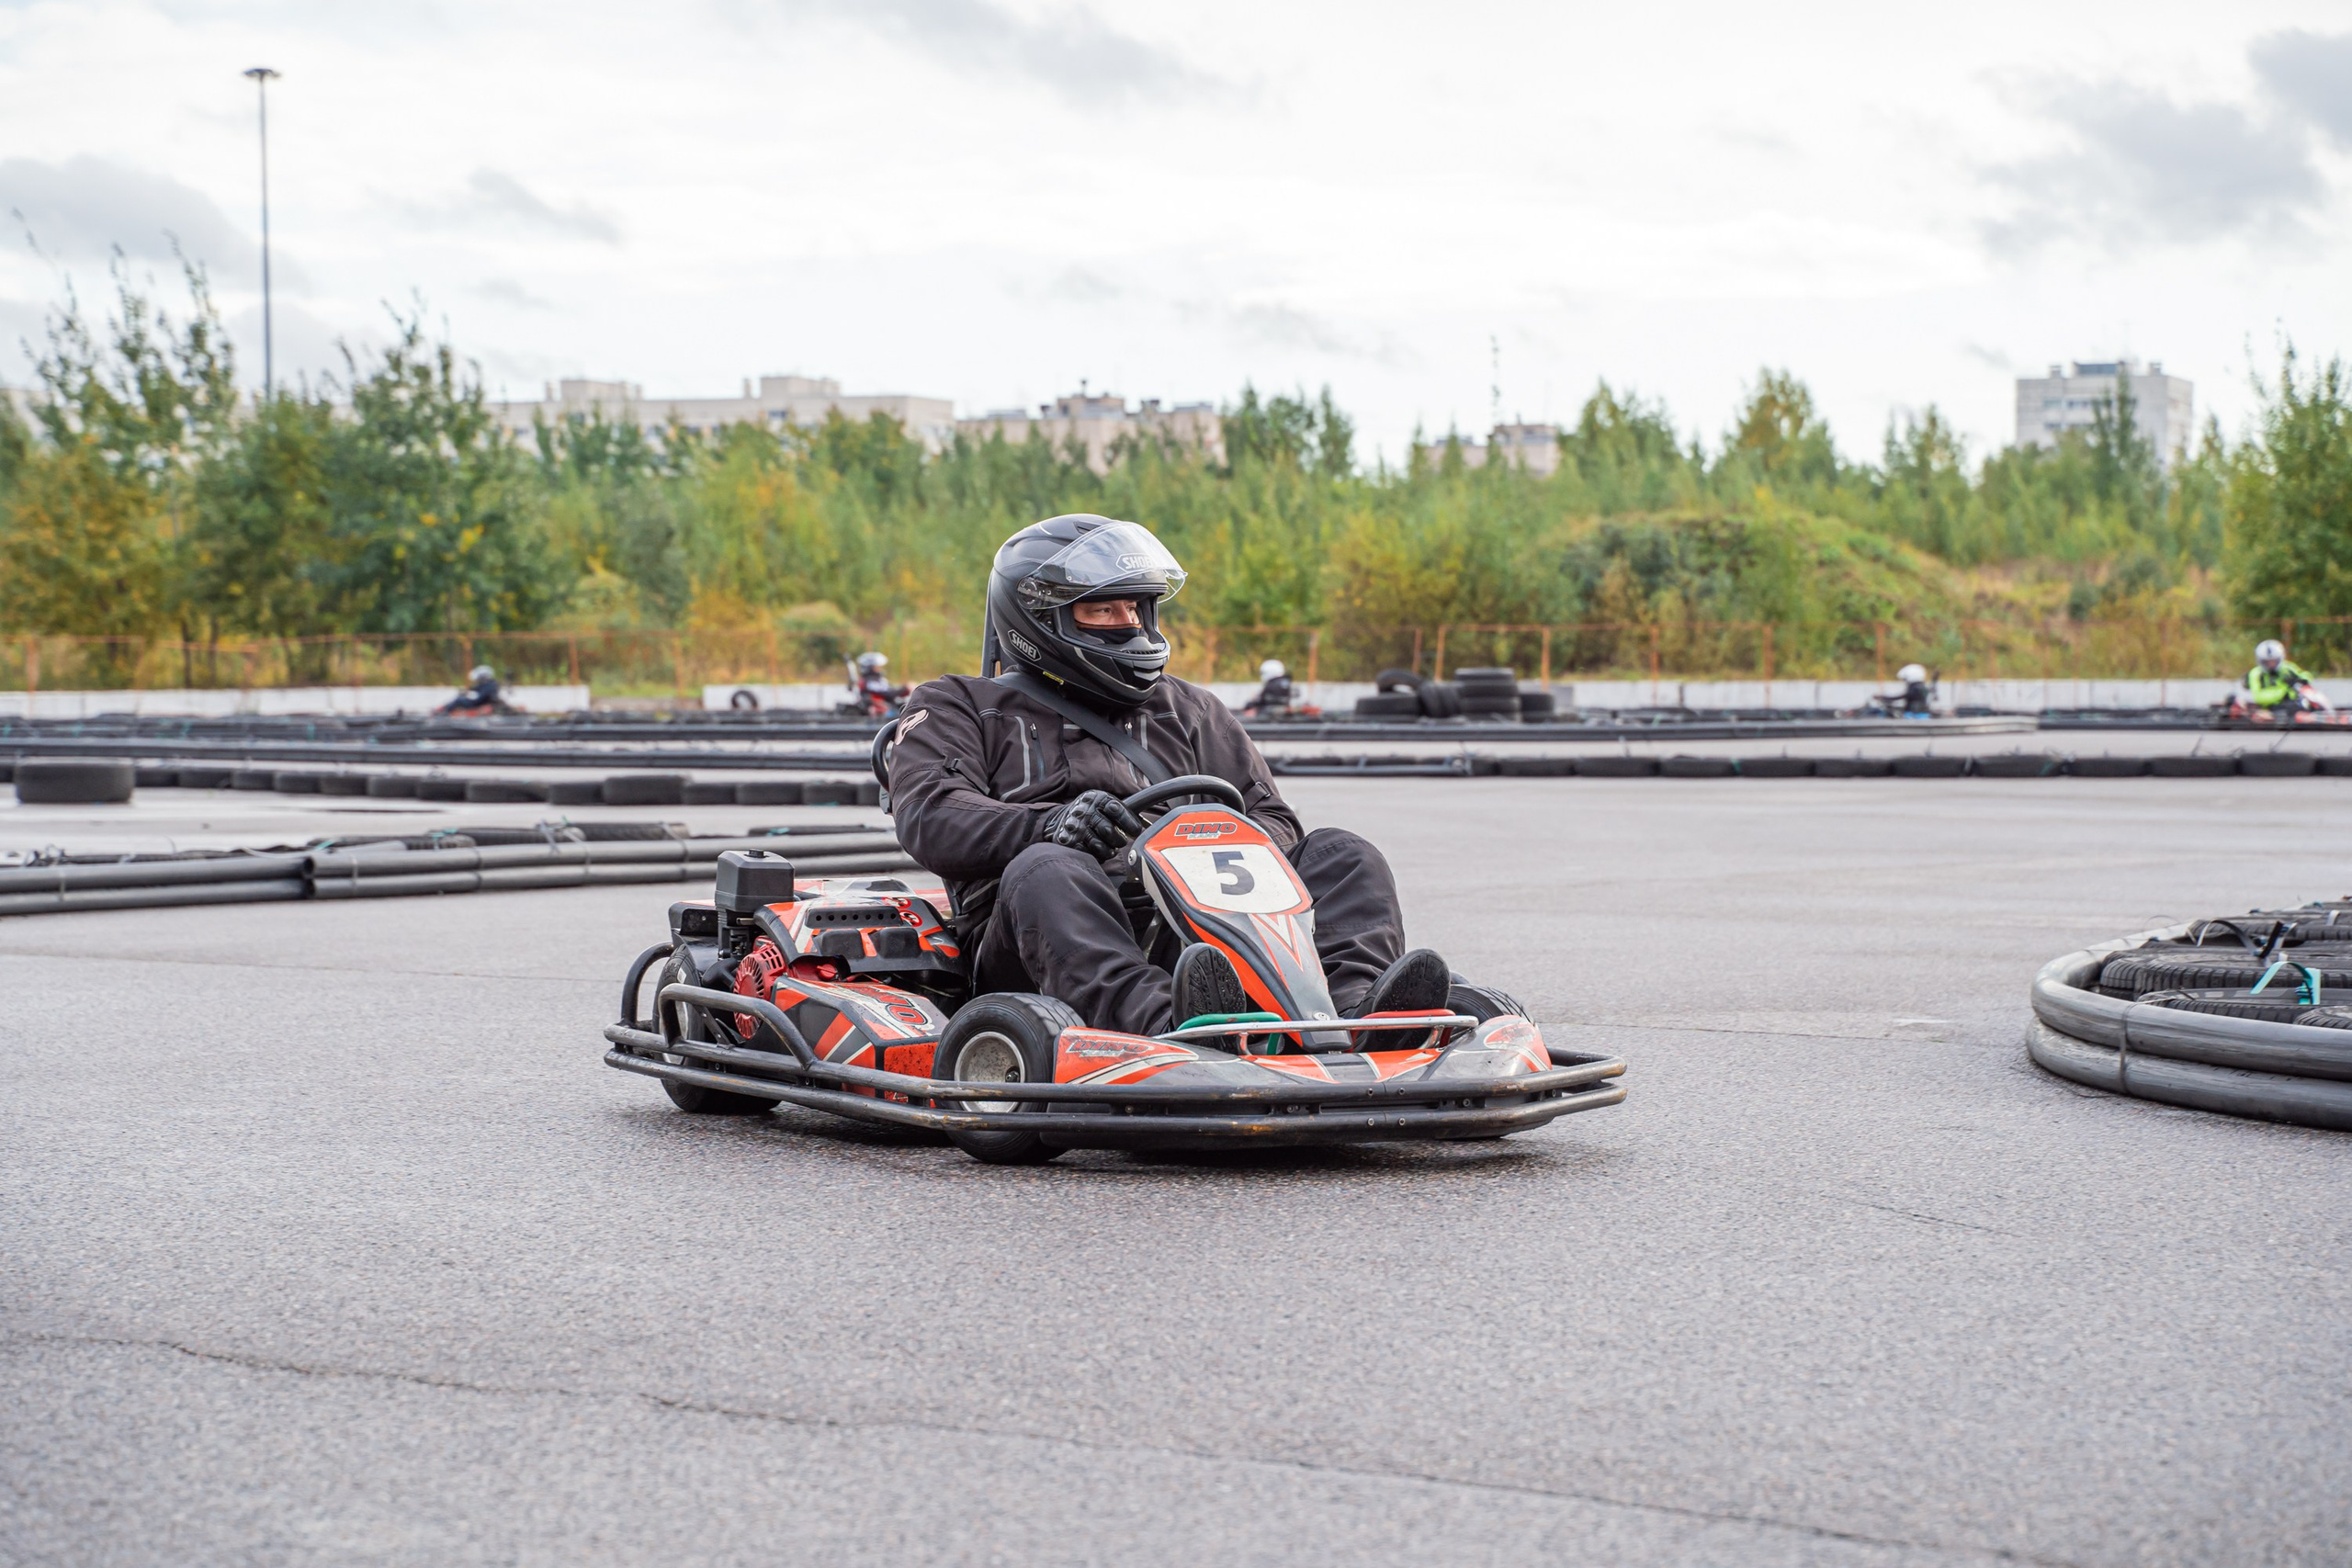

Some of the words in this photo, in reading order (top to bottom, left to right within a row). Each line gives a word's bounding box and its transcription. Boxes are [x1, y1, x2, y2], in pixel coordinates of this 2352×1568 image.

[1012, 633, 1037, 659] SHOEI
[1175, 822, 1237, 835] DINO
[1213, 852, 1255, 896] 5
[1067, 1039, 1150, 1054] DINO
